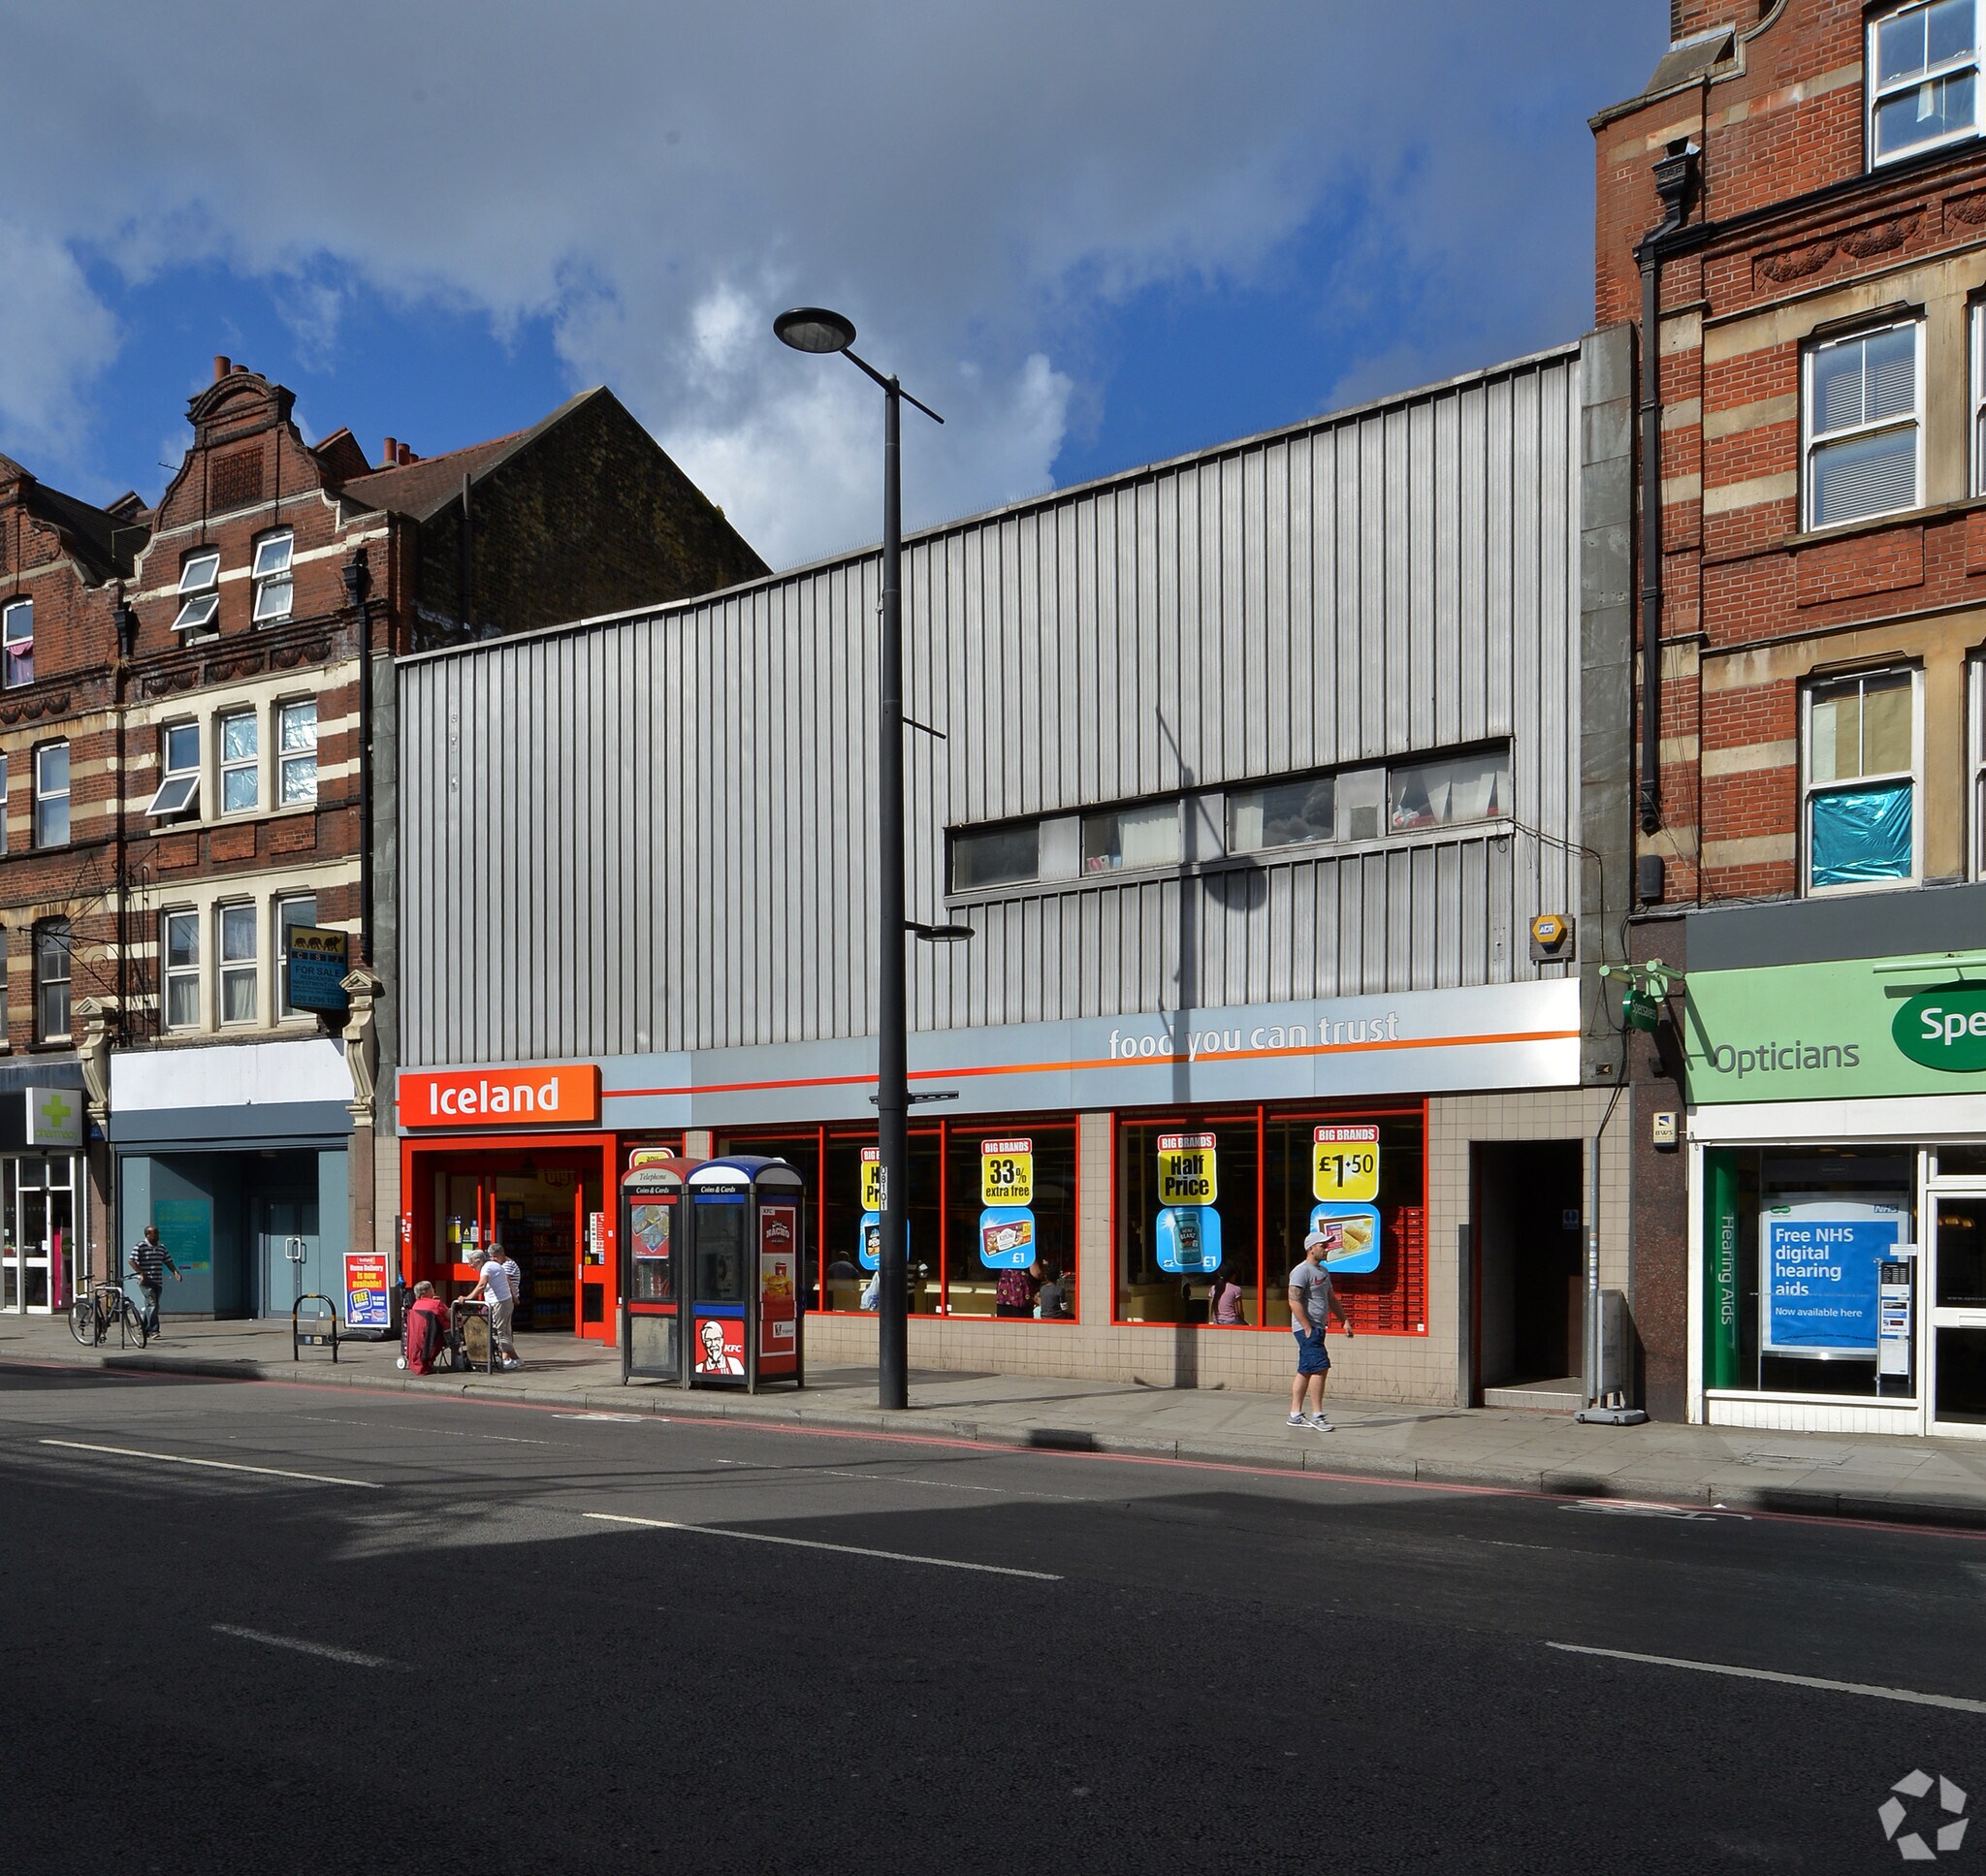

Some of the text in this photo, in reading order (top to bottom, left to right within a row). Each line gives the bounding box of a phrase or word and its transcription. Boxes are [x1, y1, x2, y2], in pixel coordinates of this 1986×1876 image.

[1539, 923, 1554, 935] ADT
[295, 966, 340, 977] FOR SALE
[1108, 1010, 1399, 1063] food you can trust
[1714, 1040, 1860, 1079] Opticians
[430, 1076, 559, 1115] Iceland
[35, 1128, 79, 1141] pharmacy
[1319, 1128, 1375, 1141] BIG BRANDS
[984, 1140, 1029, 1153] BIG BRANDS
[1162, 1135, 1212, 1149] BIG BRANDS
[864, 1150, 875, 1161] BIG
[1170, 1155, 1204, 1175] Half
[639, 1172, 667, 1182] Telephone
[990, 1159, 1027, 1185] 33%
[985, 1185, 1030, 1197] extra free
[1165, 1176, 1209, 1196] Price
[1874, 1204, 1898, 1213] NHS
[1776, 1227, 1854, 1243] Free NHS
[1011, 1252, 1025, 1263] £1
[1775, 1245, 1830, 1263] digital
[1202, 1256, 1217, 1267] £1
[1718, 1216, 1735, 1325] Hearing Aids
[1776, 1262, 1842, 1282] hearing
[1776, 1281, 1810, 1296] aids
[353, 1291, 368, 1303] FREE
[1775, 1307, 1863, 1318] Now available here
[723, 1344, 743, 1353] KFC
